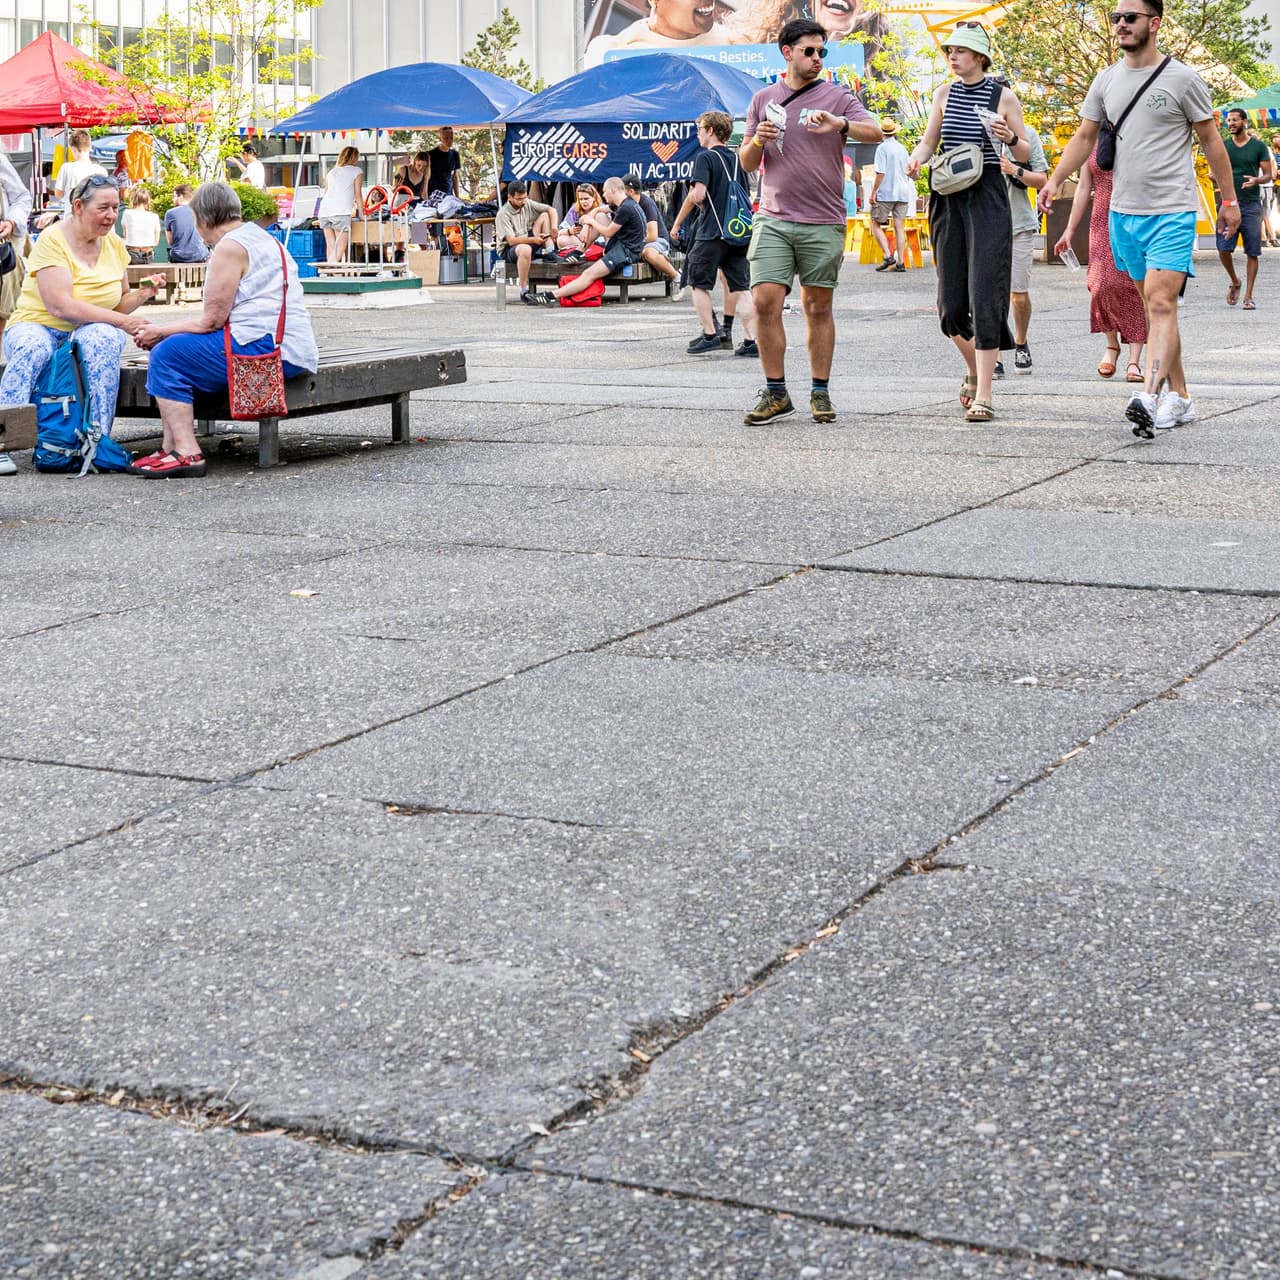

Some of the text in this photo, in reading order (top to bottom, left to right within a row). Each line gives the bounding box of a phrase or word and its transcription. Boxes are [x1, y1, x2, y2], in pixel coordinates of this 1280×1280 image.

[720, 51, 767, 64] Besties.
[622, 122, 695, 139] SOLIDARIT
[629, 162, 643, 178] IN
